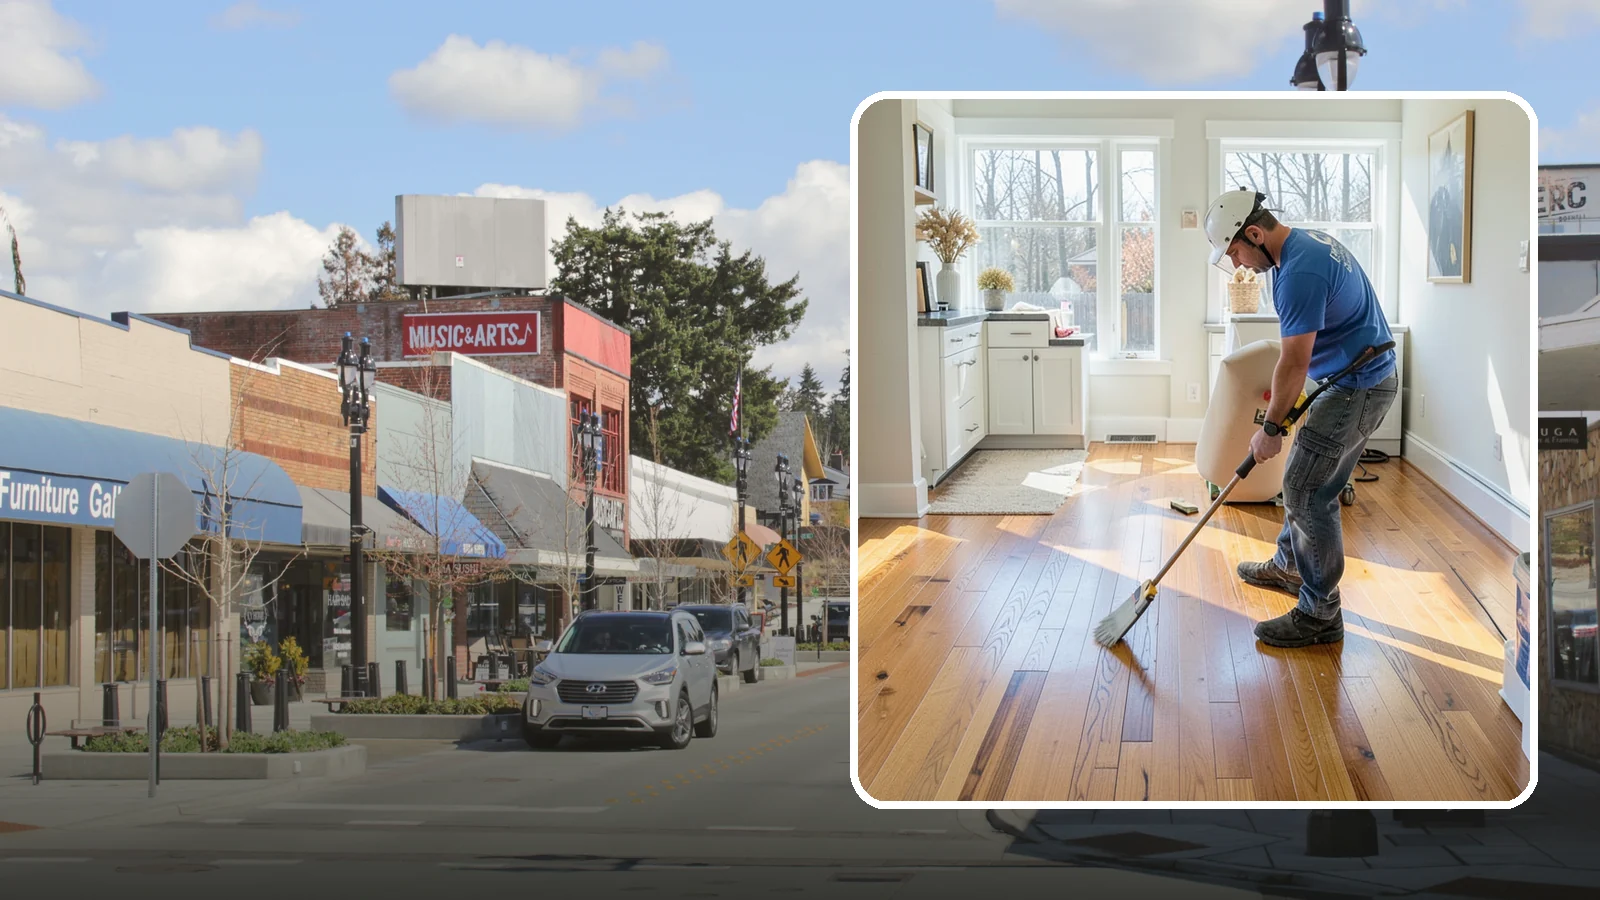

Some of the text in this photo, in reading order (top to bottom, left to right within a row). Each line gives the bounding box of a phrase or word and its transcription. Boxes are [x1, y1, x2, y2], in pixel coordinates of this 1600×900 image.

[409, 323, 519, 348] MUSIC&ARTS
[1540, 427, 1578, 437] UGA
[0, 471, 122, 519] Furniture Gal
[453, 563, 479, 574] SUSHI
